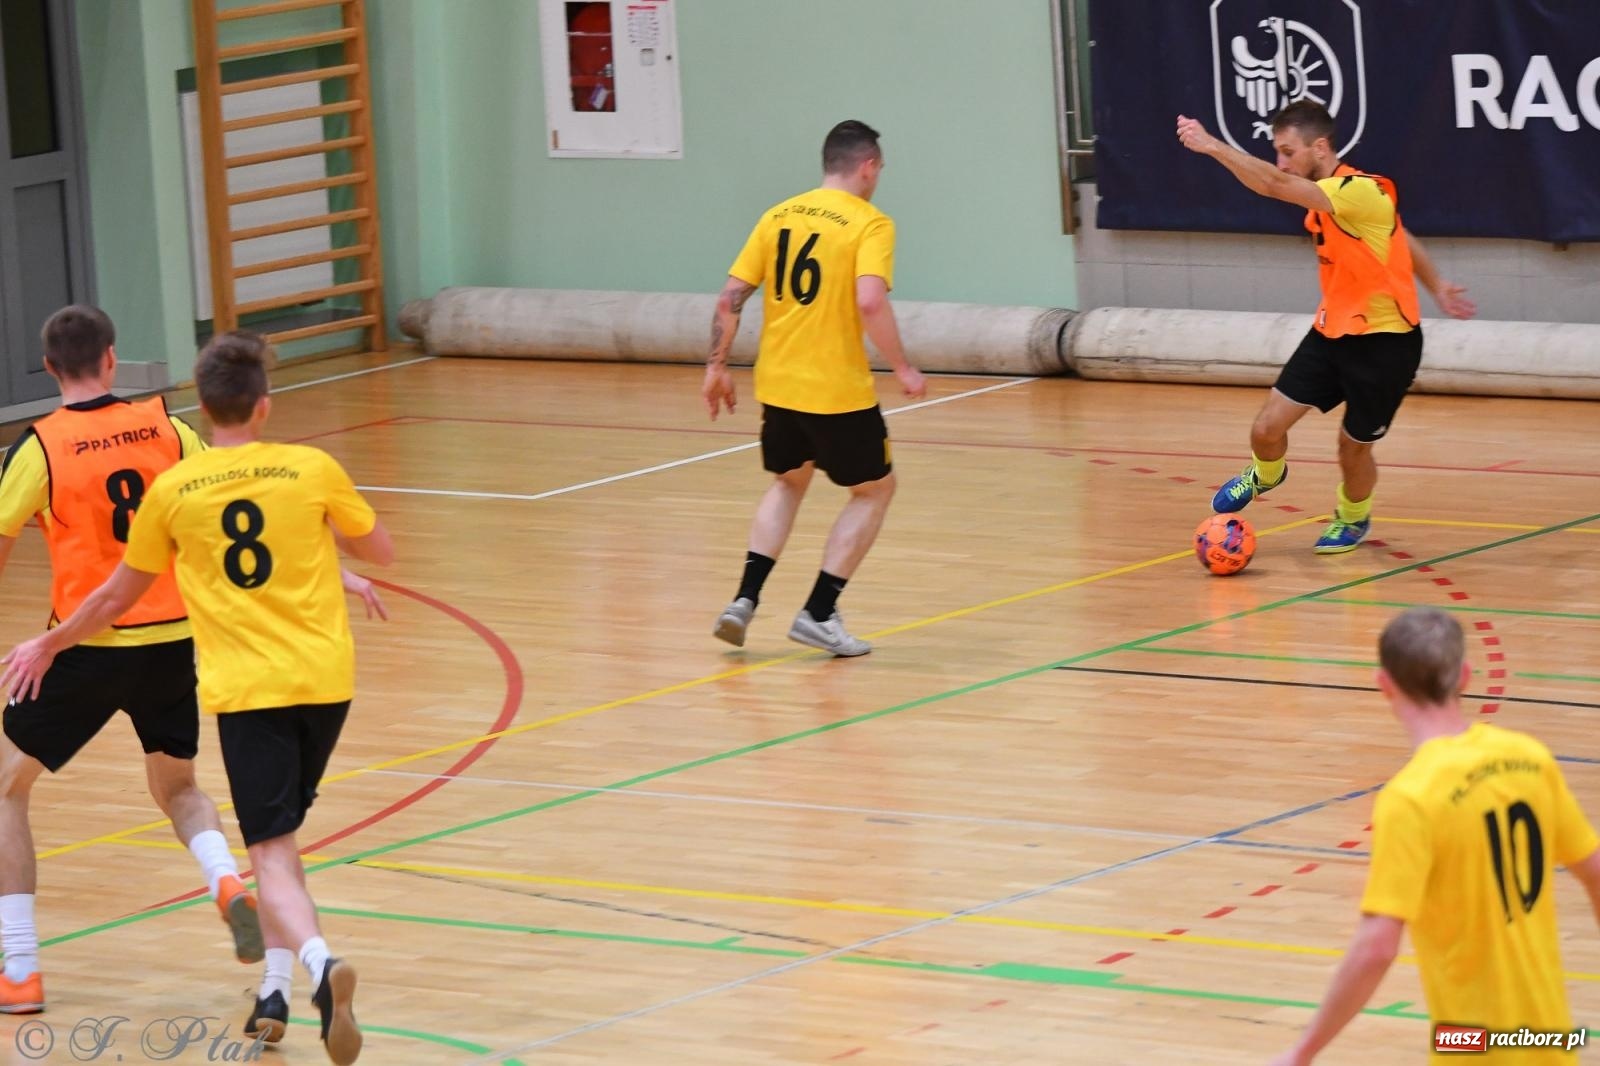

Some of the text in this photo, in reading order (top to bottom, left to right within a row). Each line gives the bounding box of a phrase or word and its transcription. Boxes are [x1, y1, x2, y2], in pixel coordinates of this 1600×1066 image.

[775, 228, 821, 305] 16
[106, 468, 145, 543] 8
[221, 498, 273, 590] 8
[1484, 799, 1544, 925] 10
